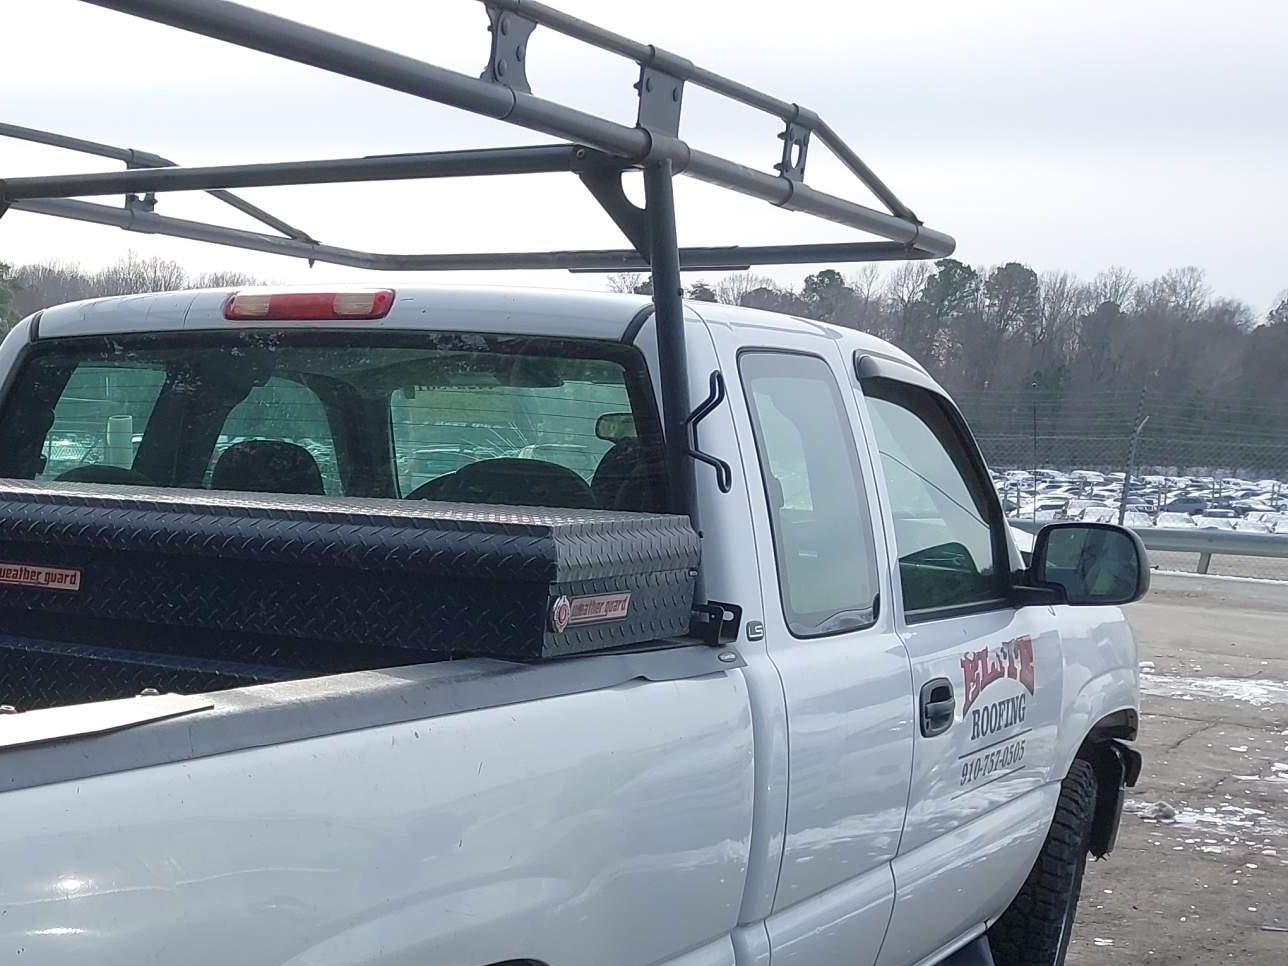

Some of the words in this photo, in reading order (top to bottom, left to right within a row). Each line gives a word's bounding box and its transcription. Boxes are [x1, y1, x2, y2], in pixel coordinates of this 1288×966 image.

[43, 570, 77, 586] guard
[970, 693, 1026, 741] ROOFING
[959, 739, 1026, 787] 910-757-0505
